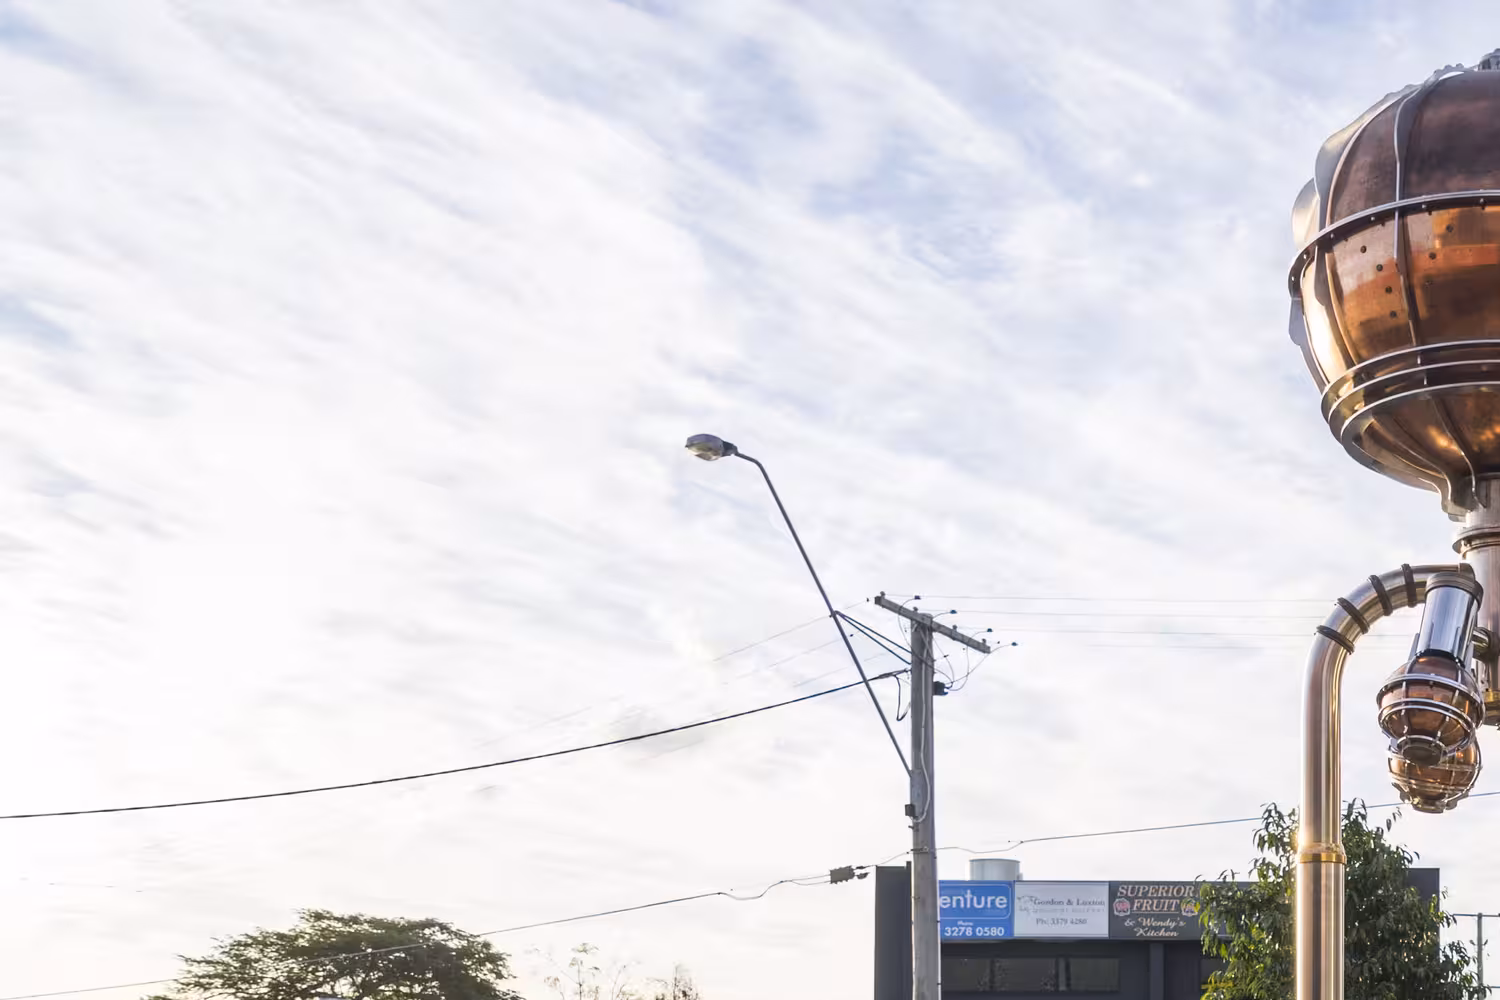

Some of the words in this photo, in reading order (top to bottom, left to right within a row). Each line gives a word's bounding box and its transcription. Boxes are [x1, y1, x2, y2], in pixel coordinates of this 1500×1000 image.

[1117, 884, 1195, 897] SUPERIOR
[1132, 898, 1180, 911] FRUIT
[1138, 916, 1186, 929] Wendy's
[944, 926, 973, 937] 3278
[975, 926, 1005, 937] 0580
[1133, 926, 1180, 937] Kitchen
